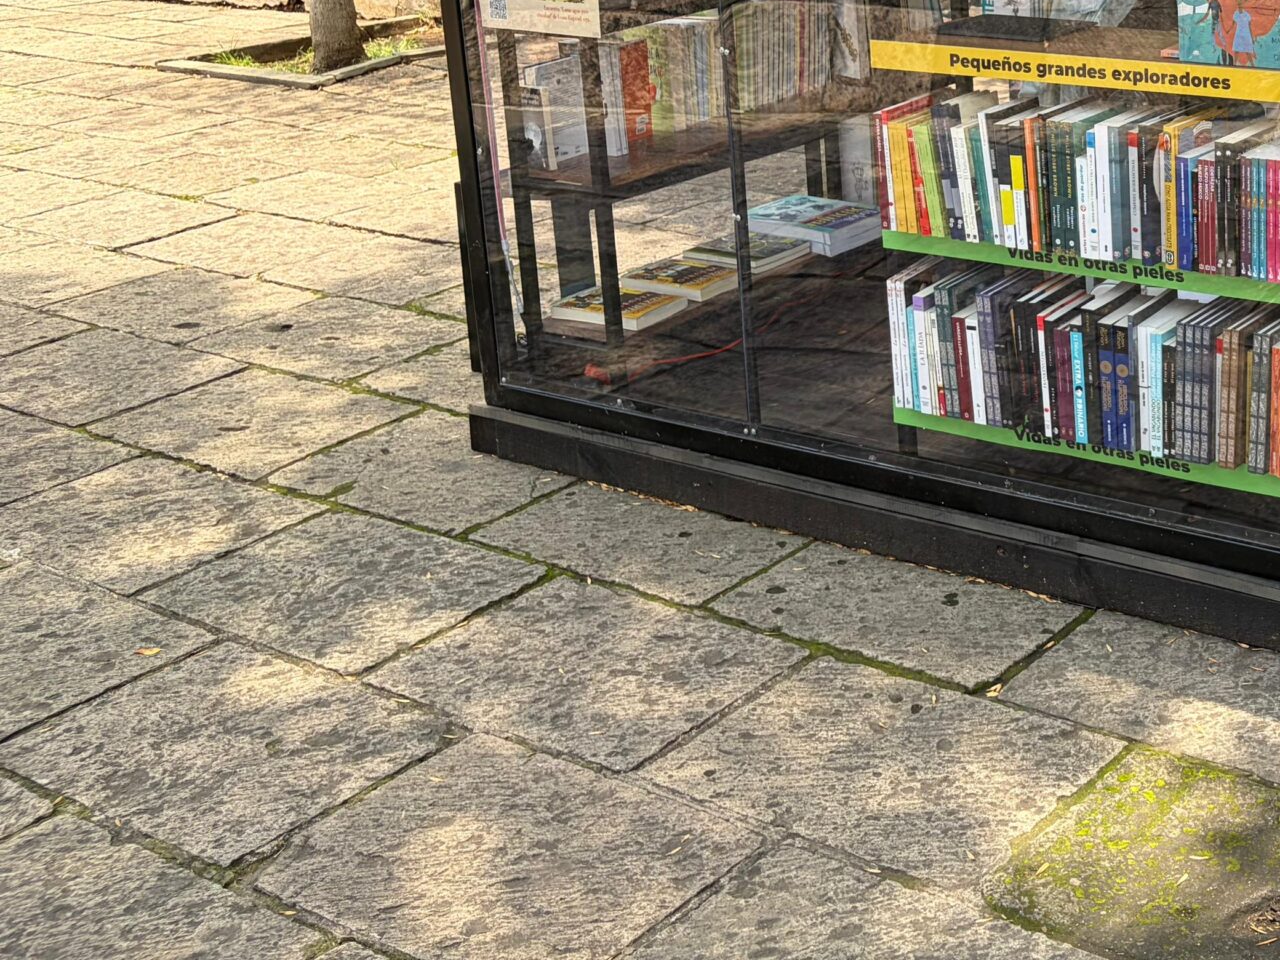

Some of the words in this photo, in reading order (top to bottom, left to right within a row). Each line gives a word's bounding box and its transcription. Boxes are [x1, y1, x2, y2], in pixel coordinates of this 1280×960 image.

[949, 53, 1032, 76] Pequeños
[1035, 61, 1107, 81] grandes
[1111, 67, 1232, 90] exploradores
[1008, 248, 1053, 265] Vidas
[1056, 256, 1079, 268] en
[1084, 257, 1128, 274] otras
[1132, 264, 1185, 285] pieles
[1091, 444, 1135, 462] otras
[1139, 451, 1191, 475] pieles
